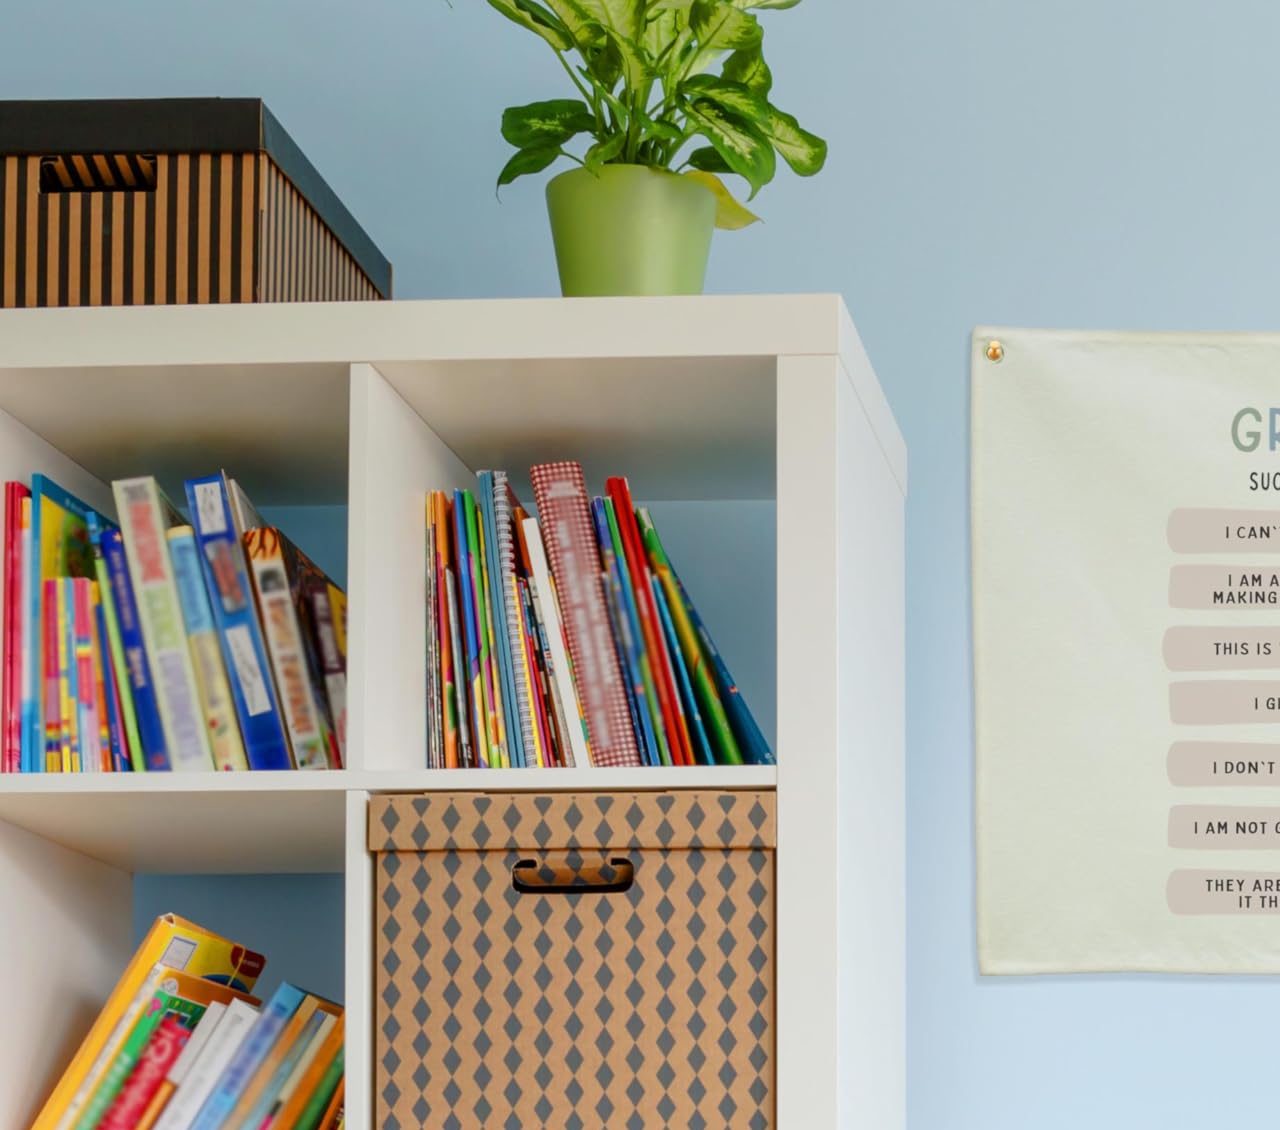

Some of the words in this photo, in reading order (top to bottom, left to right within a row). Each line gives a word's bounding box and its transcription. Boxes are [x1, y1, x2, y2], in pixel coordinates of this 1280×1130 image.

[1225, 526, 1230, 539] I
[1228, 574, 1232, 587] I
[1239, 573, 1262, 587] AM
[1213, 591, 1277, 604] MAKING
[1214, 642, 1249, 656] THIS
[1256, 642, 1272, 656] IS
[1254, 697, 1258, 710] I
[1213, 761, 1217, 774] I
[1194, 821, 1198, 834] I
[1205, 821, 1228, 835] AM
[1235, 821, 1267, 835] NOT
[1205, 879, 1245, 892] THEY
[1239, 895, 1252, 909] IT
